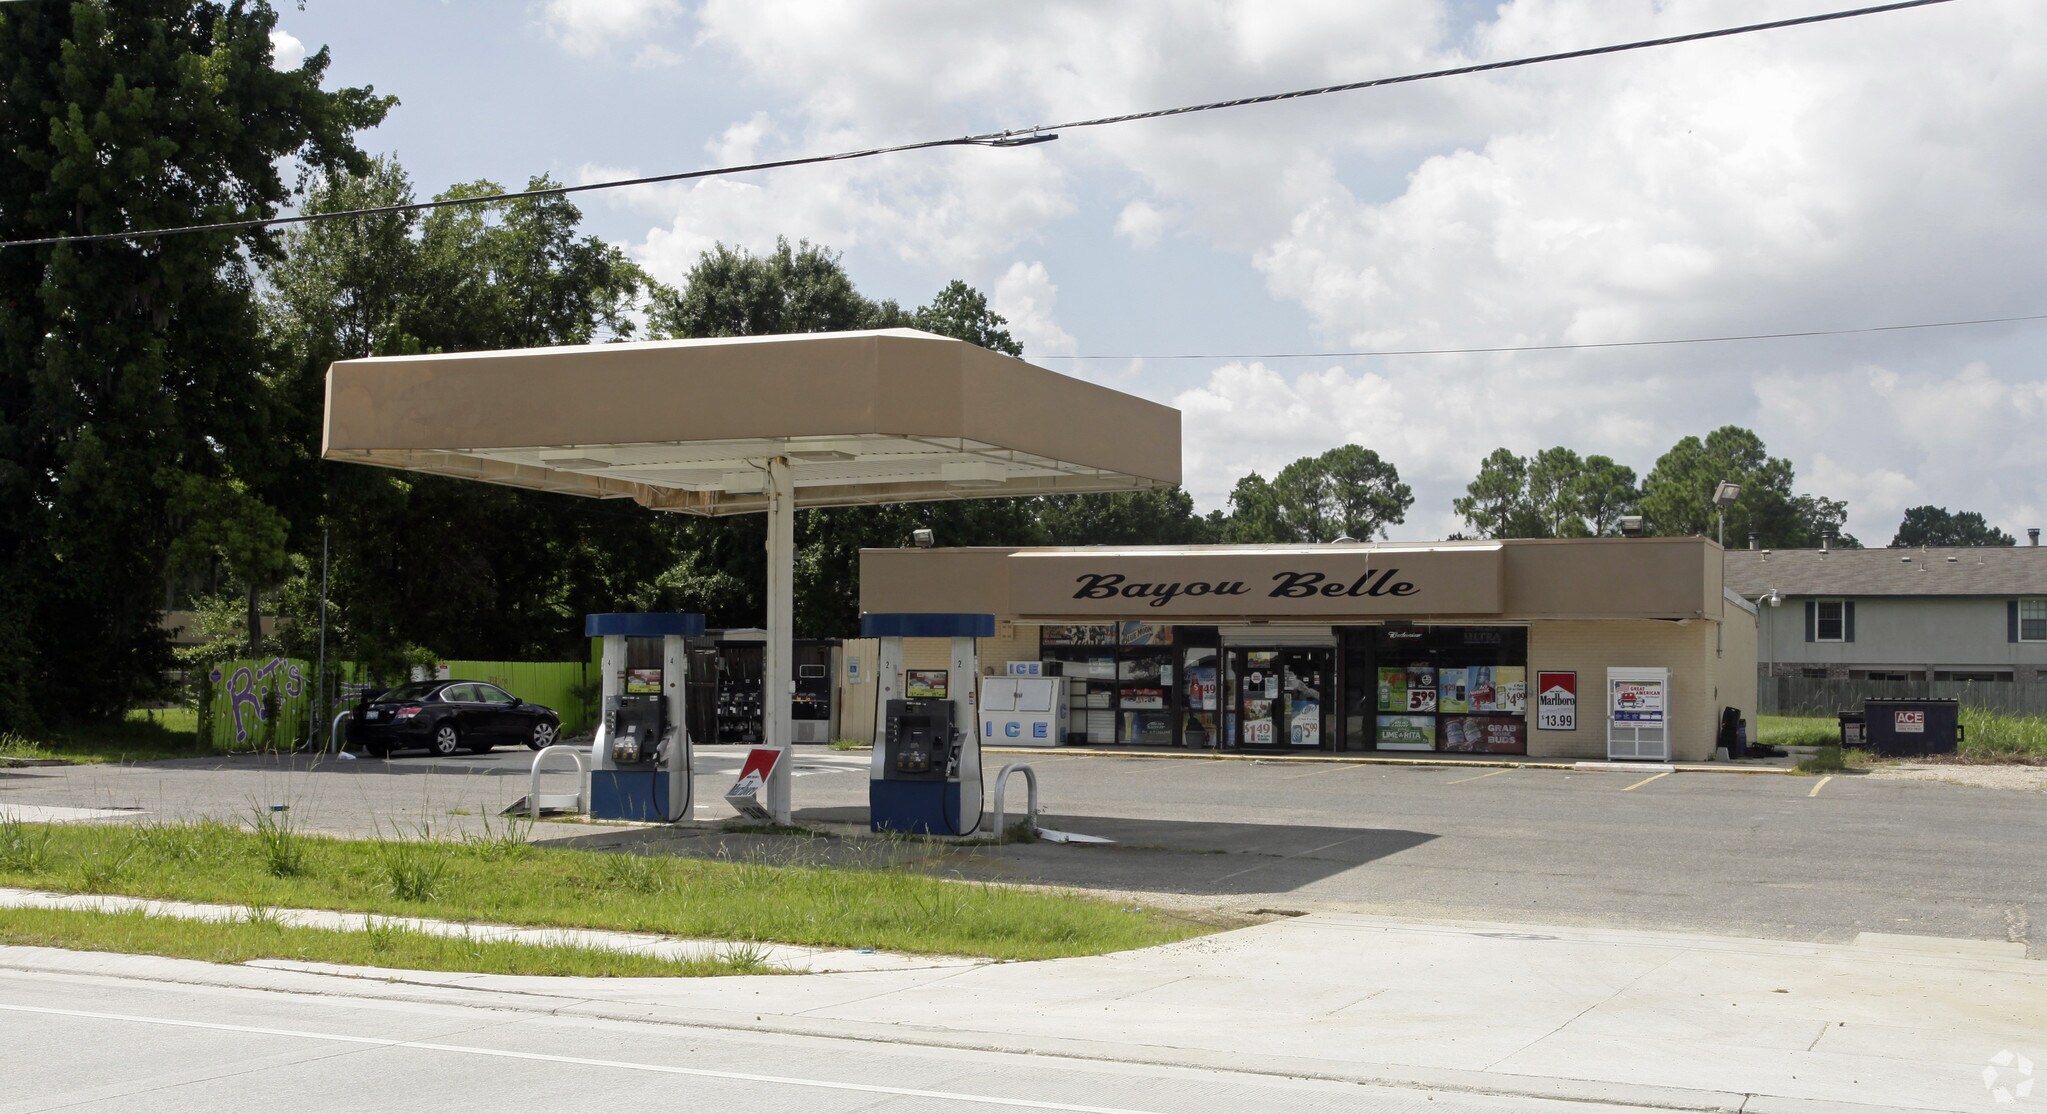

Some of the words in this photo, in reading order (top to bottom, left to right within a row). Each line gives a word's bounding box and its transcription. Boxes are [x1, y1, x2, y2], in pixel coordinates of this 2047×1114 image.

[1072, 573, 1251, 607] Bayou
[1268, 568, 1421, 598] Belle
[886, 661, 890, 669] 2
[958, 660, 962, 668] 2
[1009, 663, 1039, 674] ICE
[1540, 693, 1575, 706] Marlboro
[1897, 712, 1923, 723] ACE
[986, 721, 1048, 738] ICE
[1488, 724, 1517, 732] GRAB
[1488, 736, 1516, 744] BUDS
